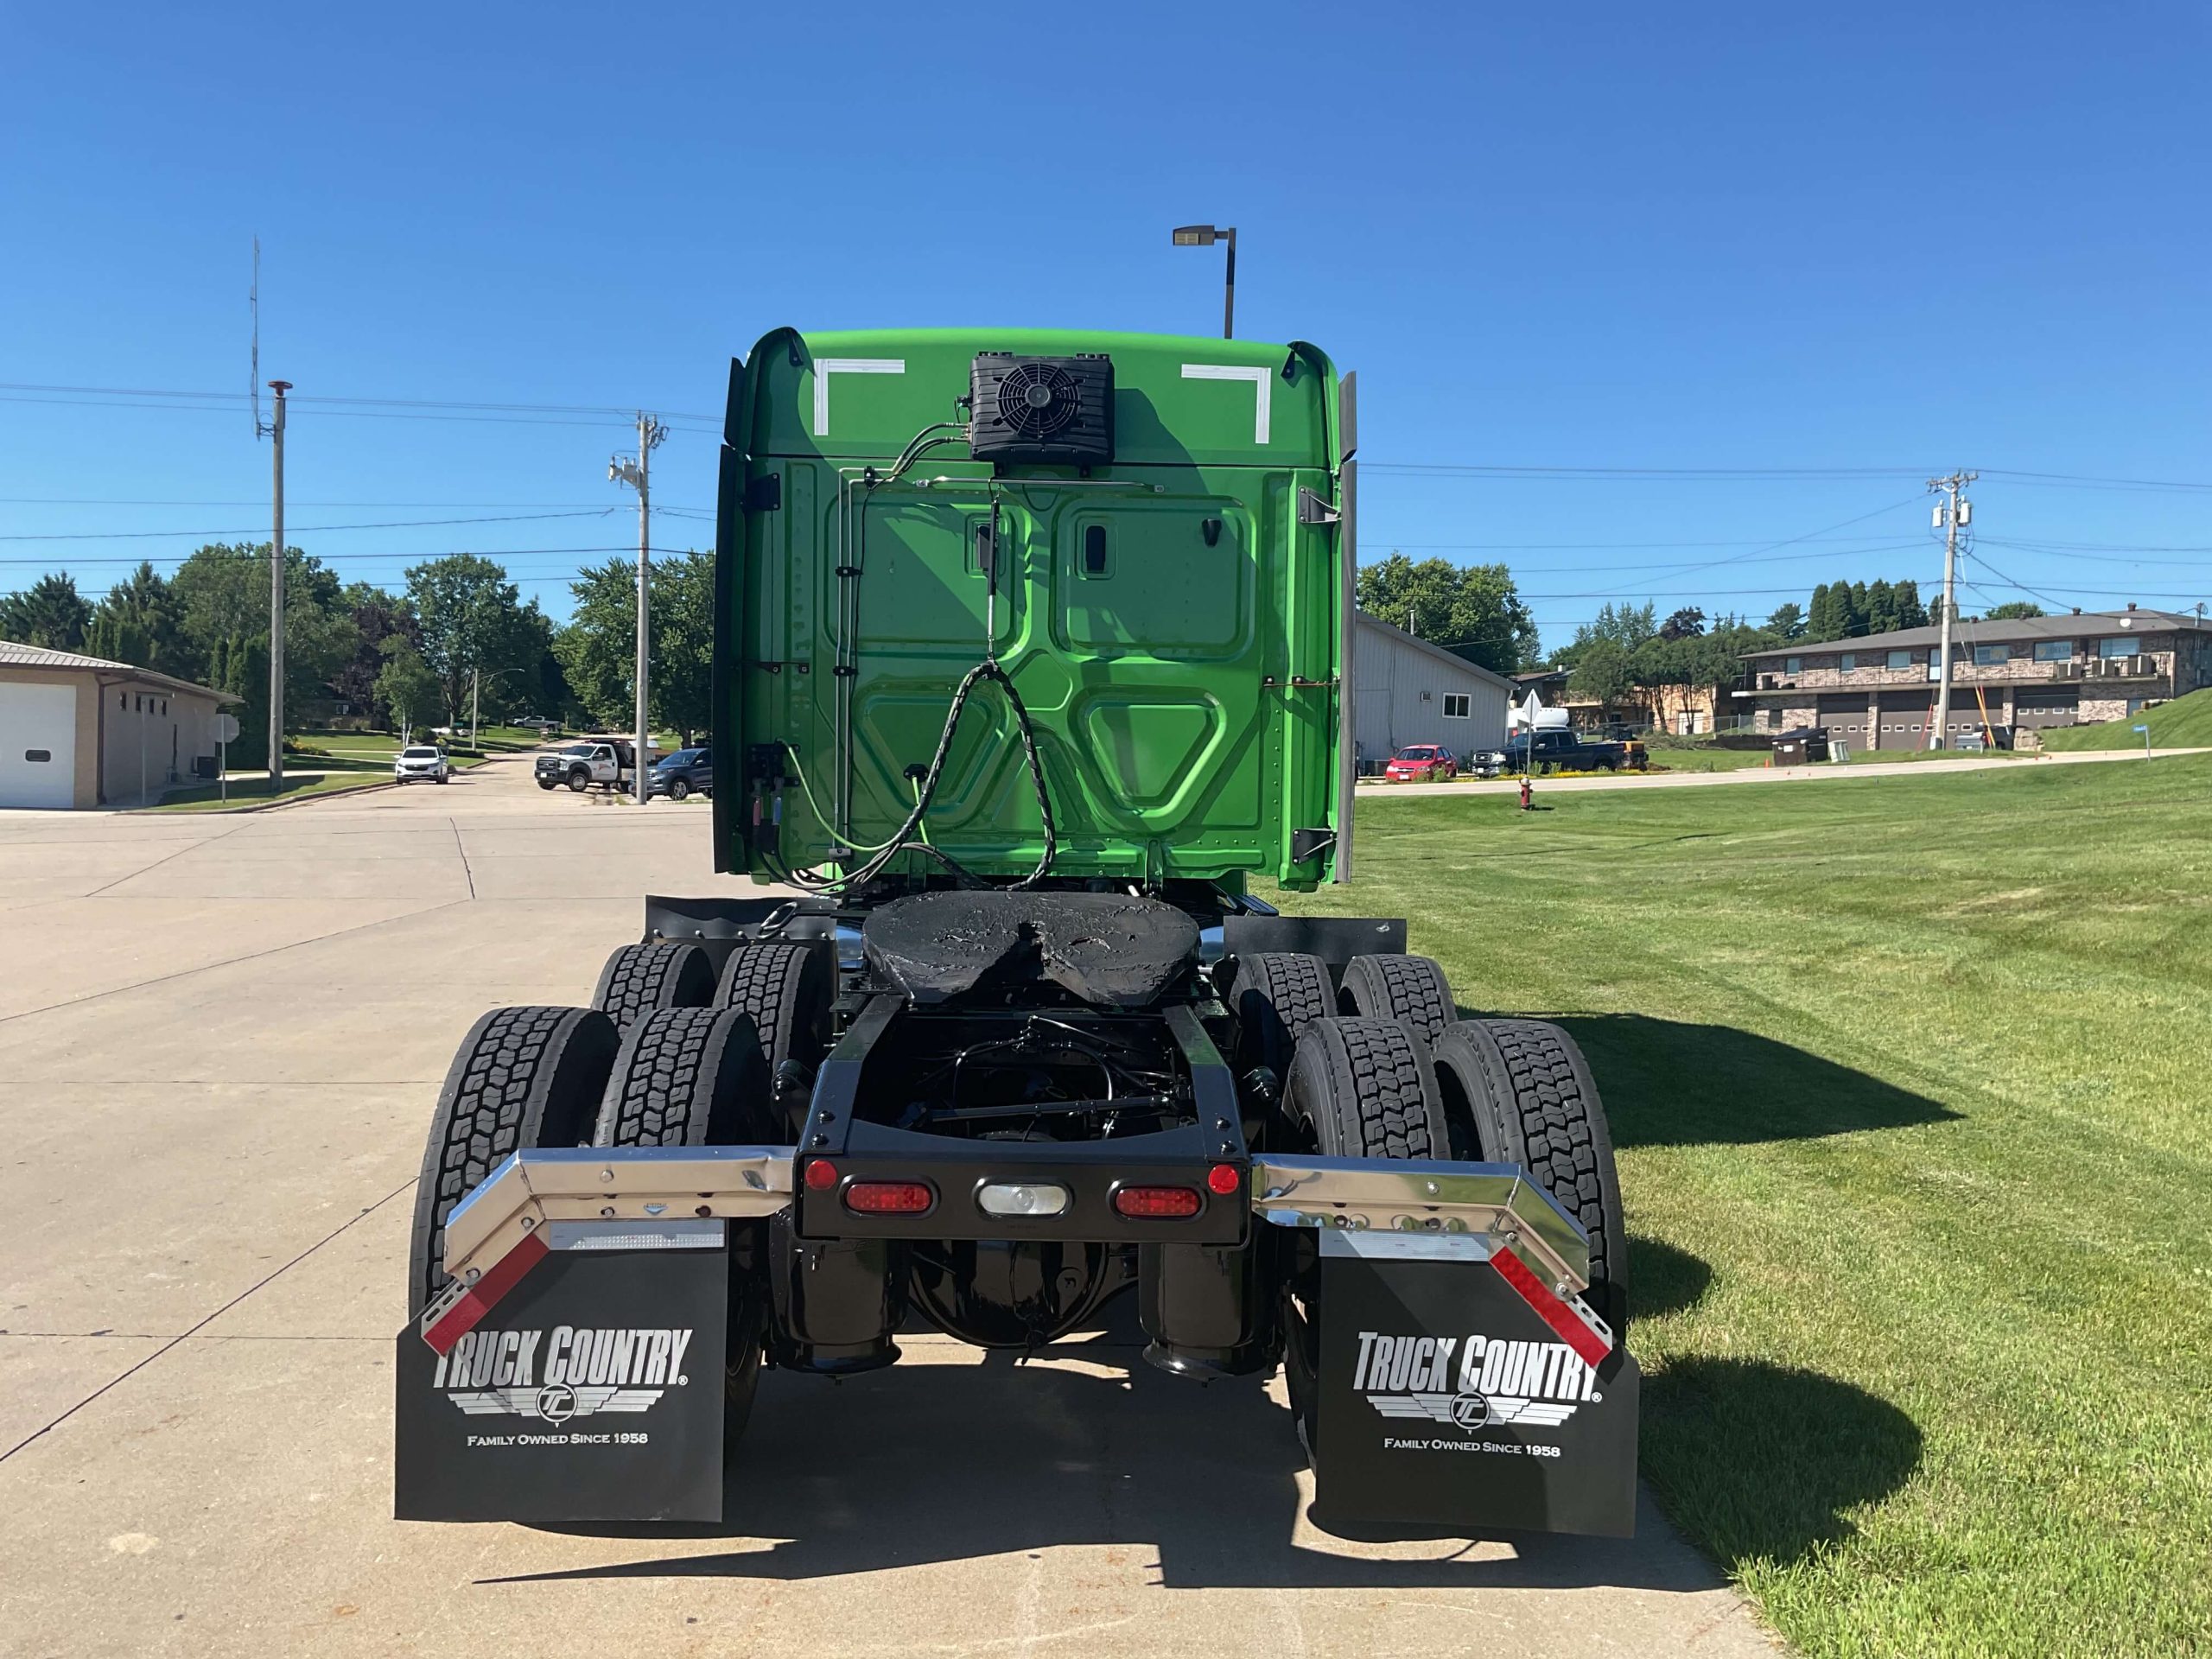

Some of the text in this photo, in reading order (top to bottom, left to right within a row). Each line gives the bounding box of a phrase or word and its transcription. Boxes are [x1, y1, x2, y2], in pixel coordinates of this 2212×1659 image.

[1353, 1332, 1457, 1392] TRUCK
[467, 1433, 648, 1446] FAMILY OWNED SINCE 1958
[1384, 1438, 1561, 1458] FAMILY OWNED SINCE 1958
